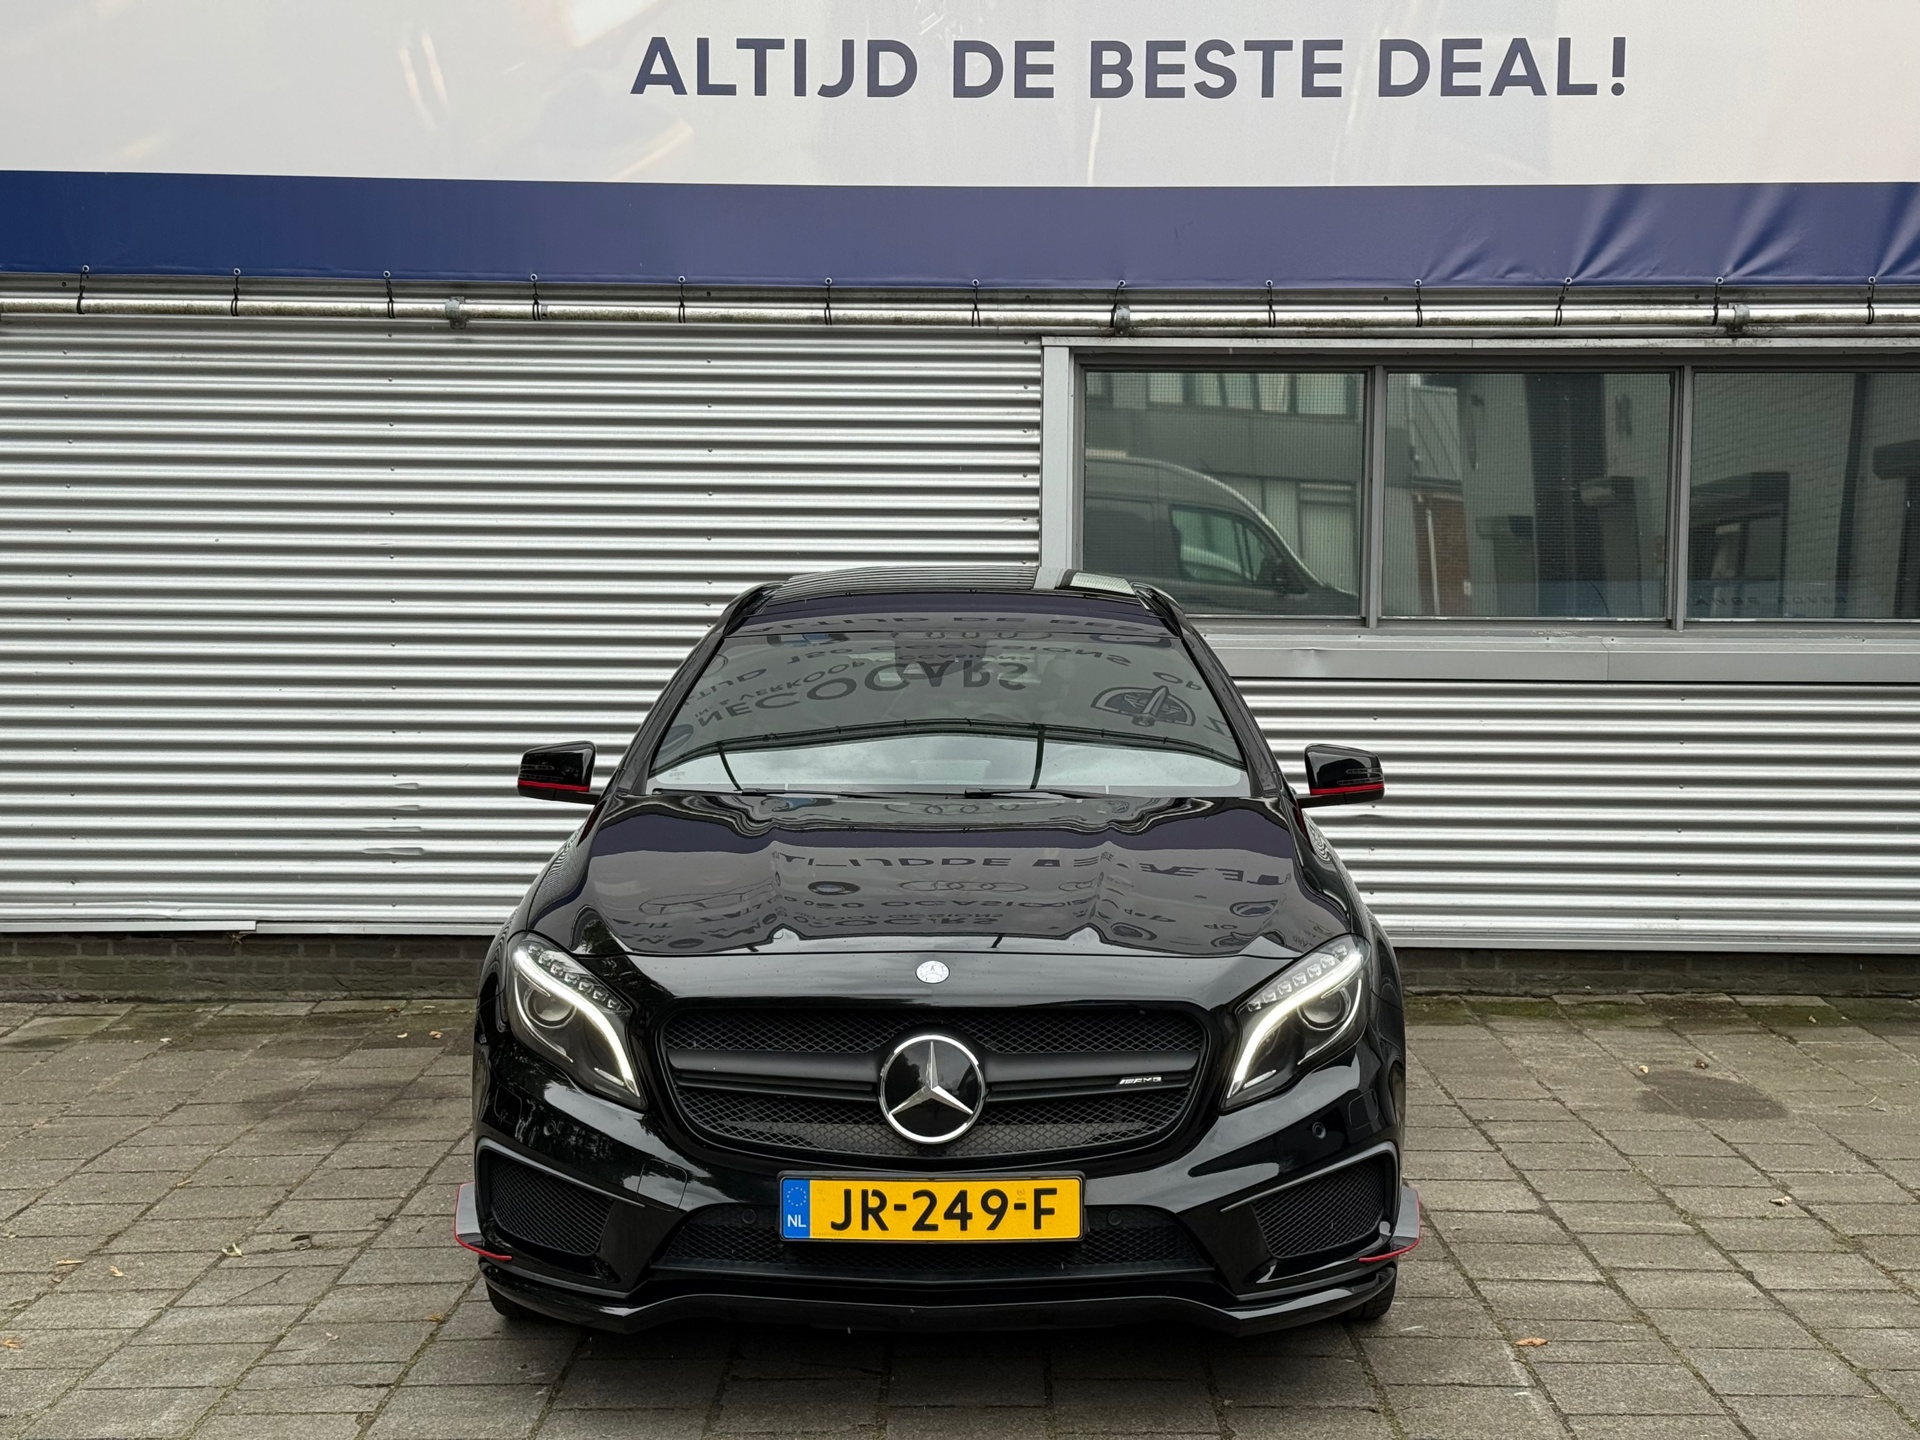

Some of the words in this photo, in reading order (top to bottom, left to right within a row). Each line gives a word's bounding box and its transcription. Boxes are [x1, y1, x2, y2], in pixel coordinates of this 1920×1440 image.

[631, 37, 918, 98] ALTIJD
[954, 40, 1055, 99] DE
[1090, 39, 1344, 99] BESTE
[1378, 36, 1626, 98] DEAL!
[787, 1214, 807, 1228] NL
[830, 1187, 1058, 1232] JR-249-F
